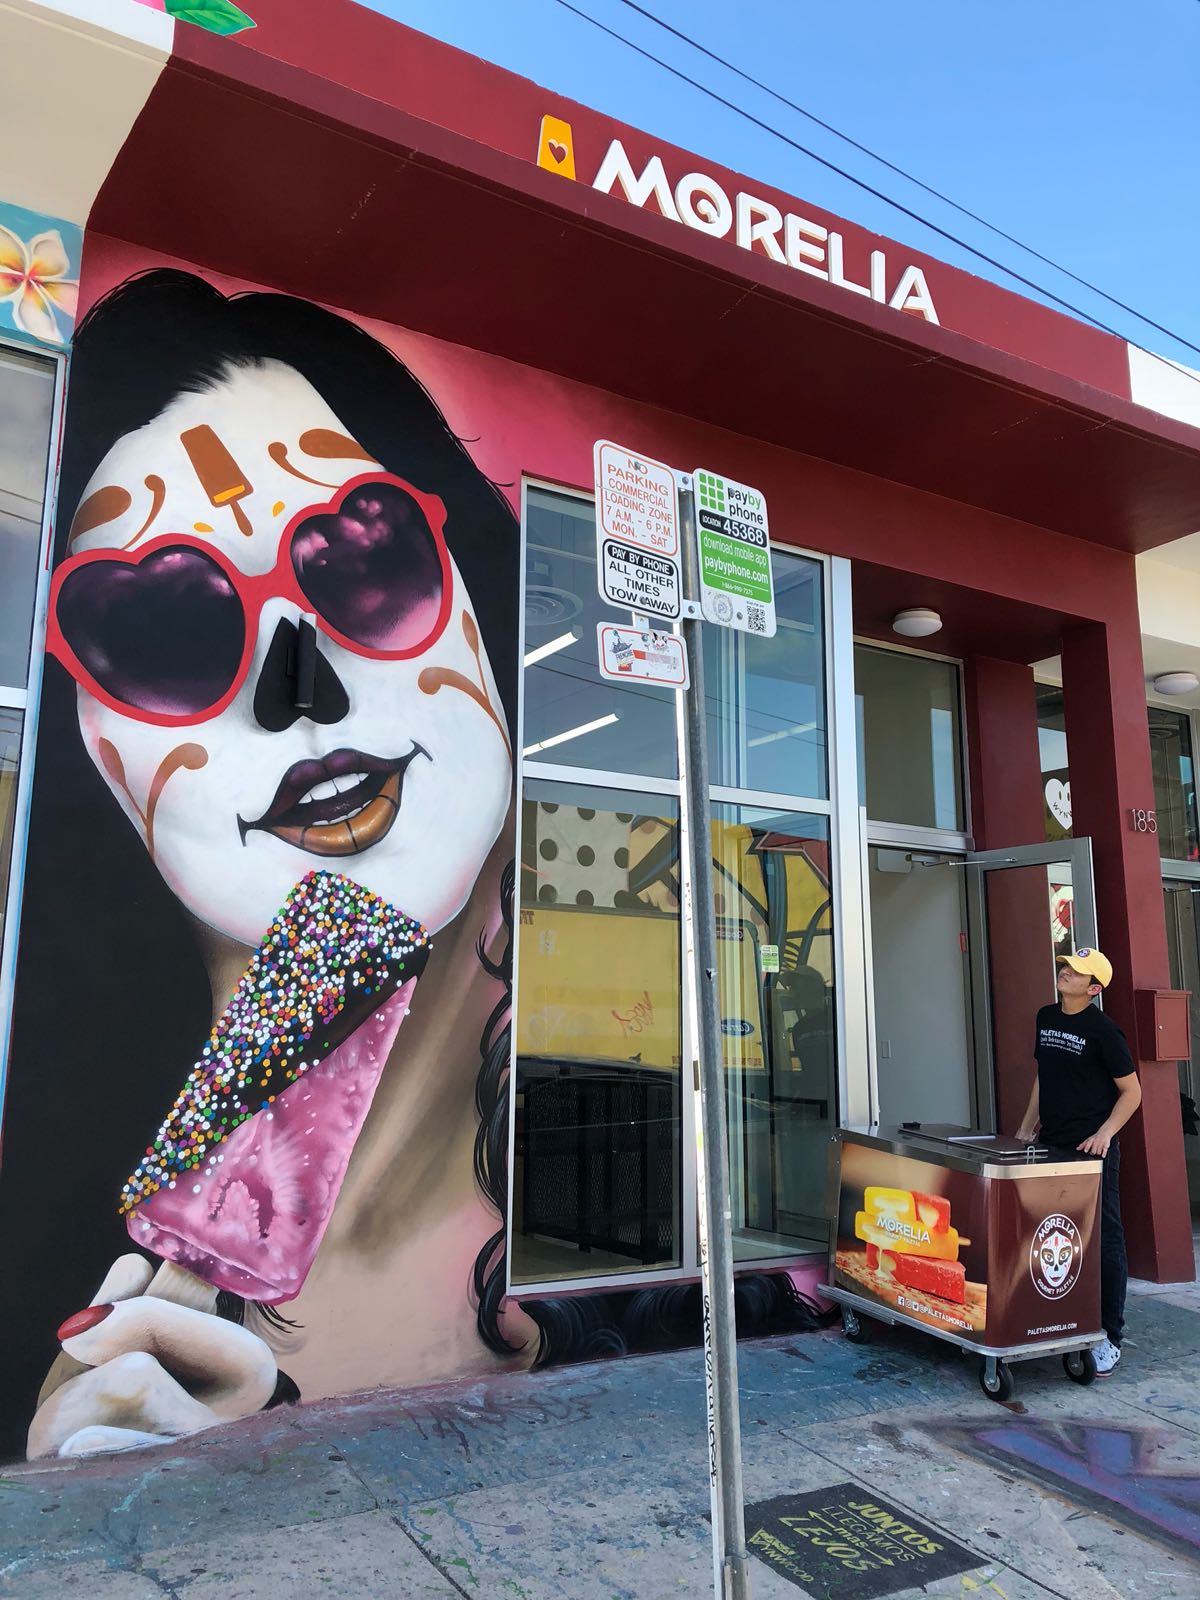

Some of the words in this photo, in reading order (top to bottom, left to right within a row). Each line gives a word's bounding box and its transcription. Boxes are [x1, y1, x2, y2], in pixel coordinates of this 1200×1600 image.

[592, 139, 940, 326] MORELIA
[608, 464, 668, 496] PARKING
[627, 459, 648, 474] NO
[605, 491, 645, 513] LOADING
[649, 507, 672, 524] ZONE
[608, 478, 668, 509] COMMERCIAL
[728, 487, 761, 510] payby
[606, 505, 612, 515] 7
[616, 509, 634, 524] A.M.
[646, 520, 652, 529] 6
[656, 523, 673, 537] P.M.
[729, 503, 764, 525] phone
[612, 521, 637, 538] MON.
[651, 534, 668, 547] SAT
[703, 515, 721, 527] LOCATION
[723, 519, 764, 545] 45368
[612, 546, 626, 559] PAY
[629, 552, 640, 564] BY
[643, 558, 670, 575] PHONE
[704, 534, 733, 555] download
[734, 546, 754, 561] mobile
[756, 554, 767, 568] app
[609, 561, 631, 575] ALL
[636, 569, 674, 589] OTHER
[704, 555, 769, 584] paybyphone.com
[609, 586, 637, 602] TOW
[642, 597, 675, 613] AWAY
[624, 577, 660, 597] TIMES
[1132, 808, 1157, 833] 185
[1062, 1032, 1086, 1045] MORELIA
[877, 1215, 931, 1244] MORELIA
[1038, 1218, 1075, 1242] MORELIA
[1027, 1323, 1077, 1336] PALETASMORELIA.COM
[822, 1506, 915, 1562] LLEGAMOS
[833, 1527, 869, 1548] mas
[848, 1501, 945, 1554] JUNTOS
[779, 1518, 881, 1571] LEJOS
